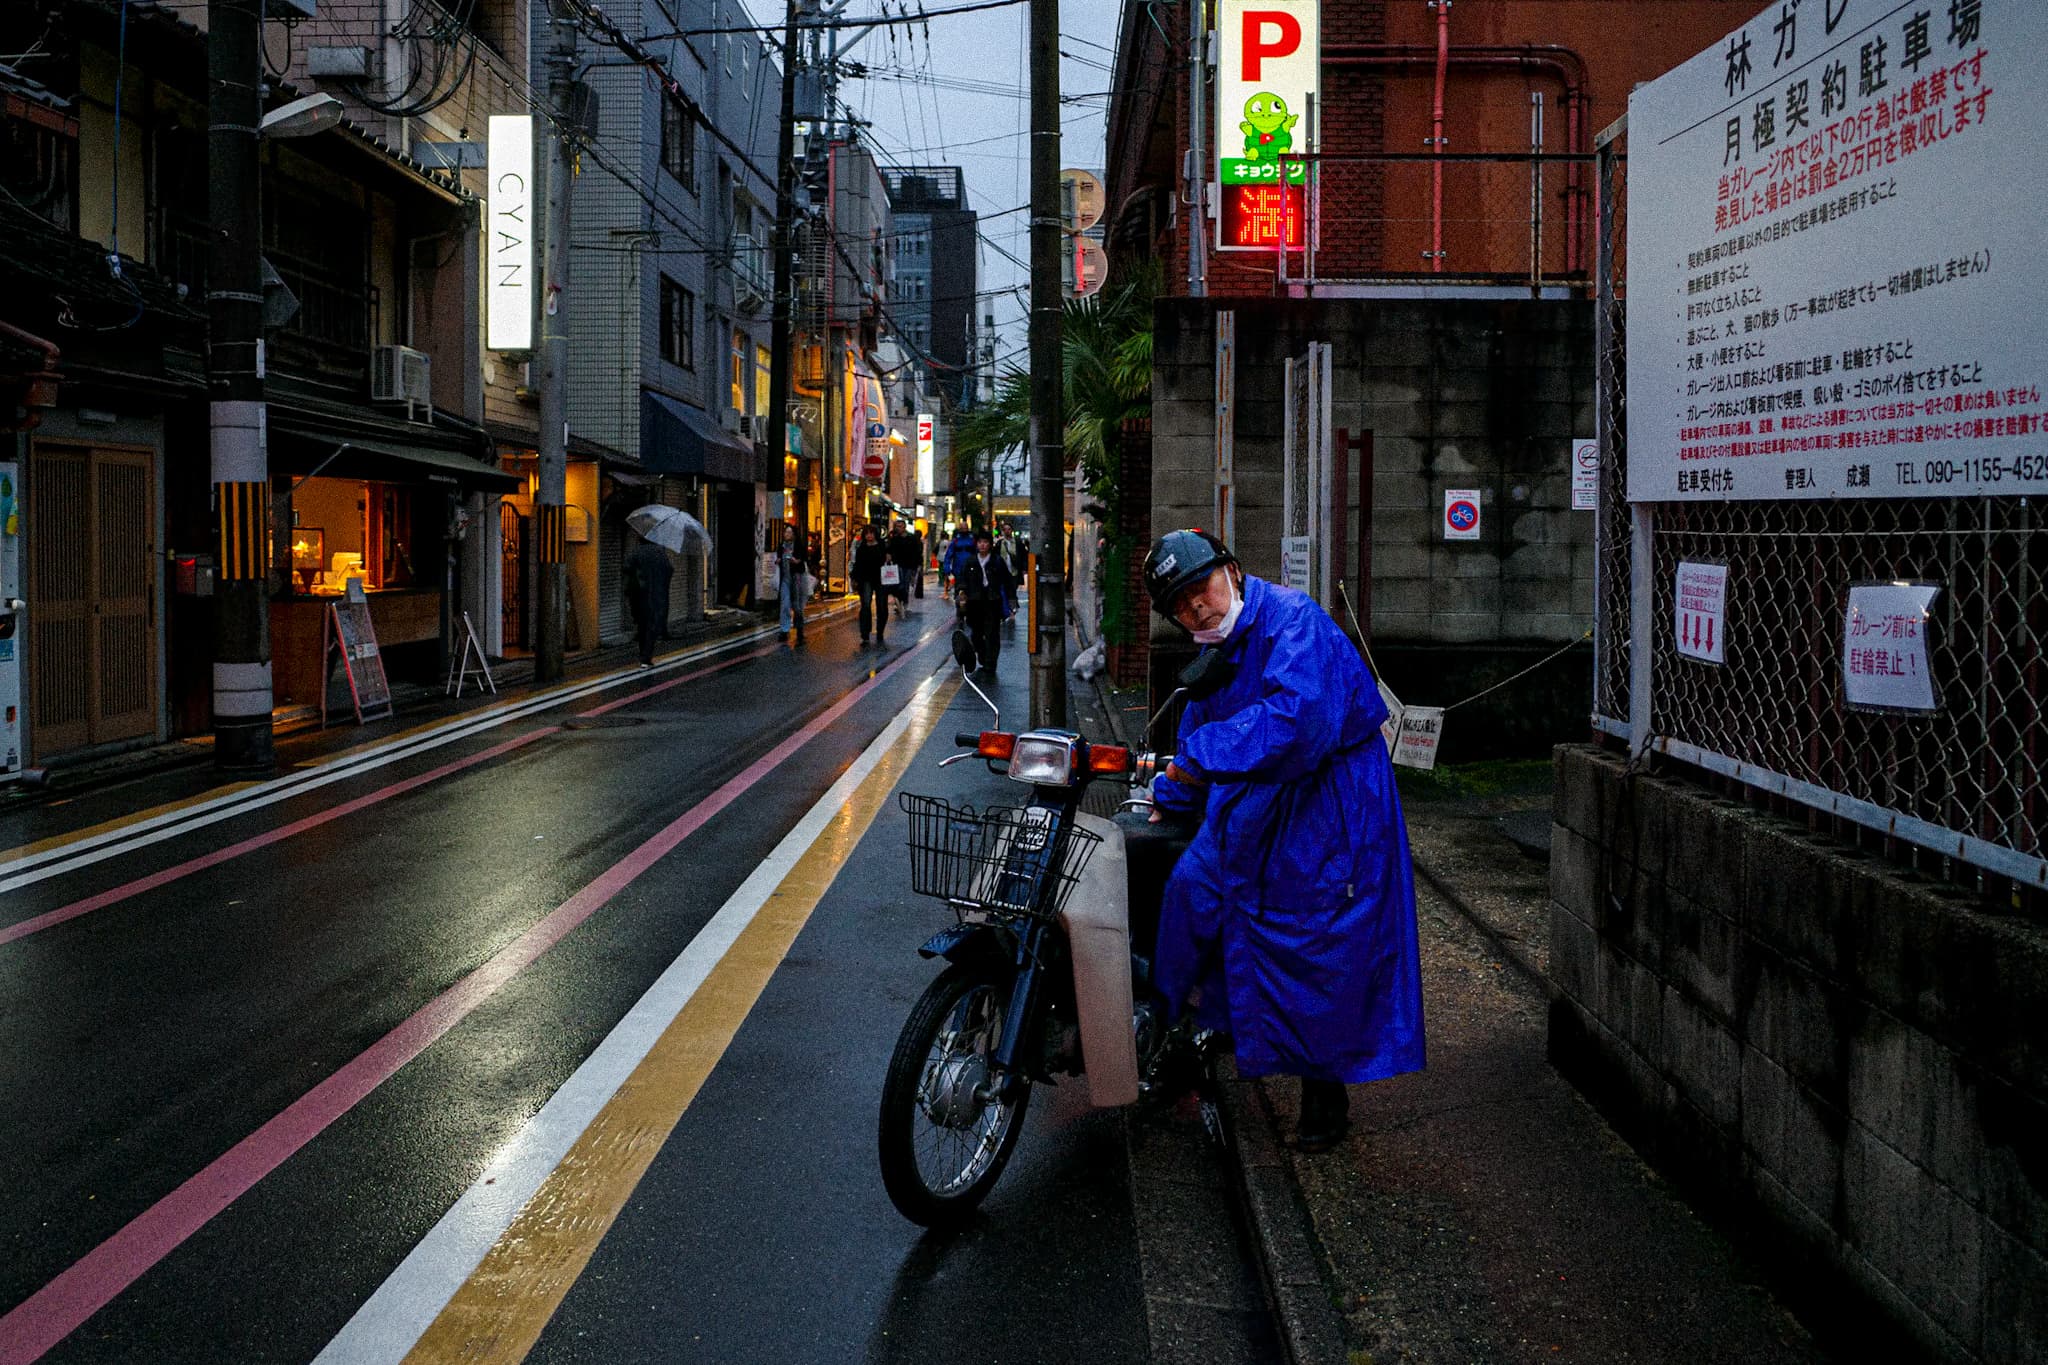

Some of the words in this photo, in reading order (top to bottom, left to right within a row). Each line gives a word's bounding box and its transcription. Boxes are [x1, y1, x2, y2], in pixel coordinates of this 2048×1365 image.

[1241, 11, 1301, 82] P
[1722, 0, 1983, 167] 月極契約駐車場
[1717, 47, 1989, 202] 当ガレージ内で以下の行為は厳禁です
[498, 173, 524, 287] CYAN
[1240, 189, 1294, 242] 満
[1677, 466, 1735, 493] 駐車受付先
[1785, 466, 1816, 490] 管理人
[1846, 463, 1871, 488] 成瀬
[1851, 613, 1917, 639] ガレージ前は
